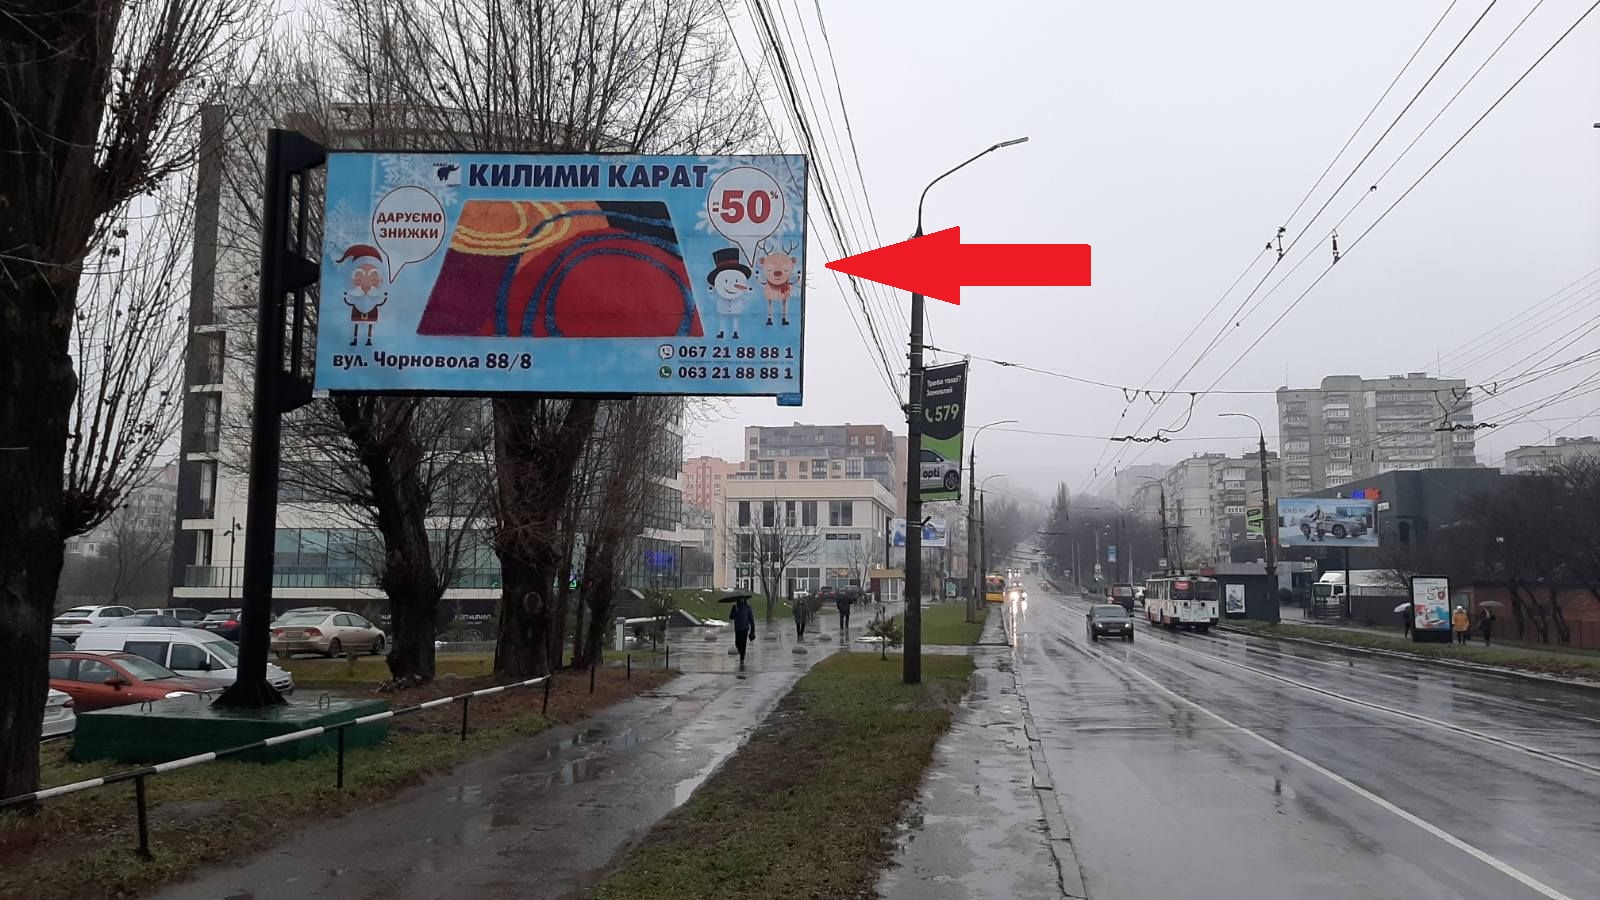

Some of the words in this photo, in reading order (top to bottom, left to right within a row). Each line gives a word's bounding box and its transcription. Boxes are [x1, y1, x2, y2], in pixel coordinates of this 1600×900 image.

[469, 163, 599, 188] КИЛИМИ
[608, 165, 709, 188] КАРАТ
[376, 212, 442, 225] ДАРУЄМО
[380, 228, 439, 239] ЗНИЖКИ
[678, 345, 708, 359] 067
[712, 346, 732, 359] 21
[736, 346, 756, 359] 88
[760, 346, 779, 360] 88
[784, 347, 794, 360] 1
[332, 354, 368, 370] вул.
[374, 351, 480, 370] Чорновола
[485, 353, 532, 372] 88/8
[678, 366, 707, 379] 063
[711, 367, 731, 379] 21
[735, 367, 755, 380] 88
[760, 367, 779, 380] 88
[784, 368, 793, 380] 1
[934, 403, 960, 422] 579
[922, 467, 940, 479] opti
